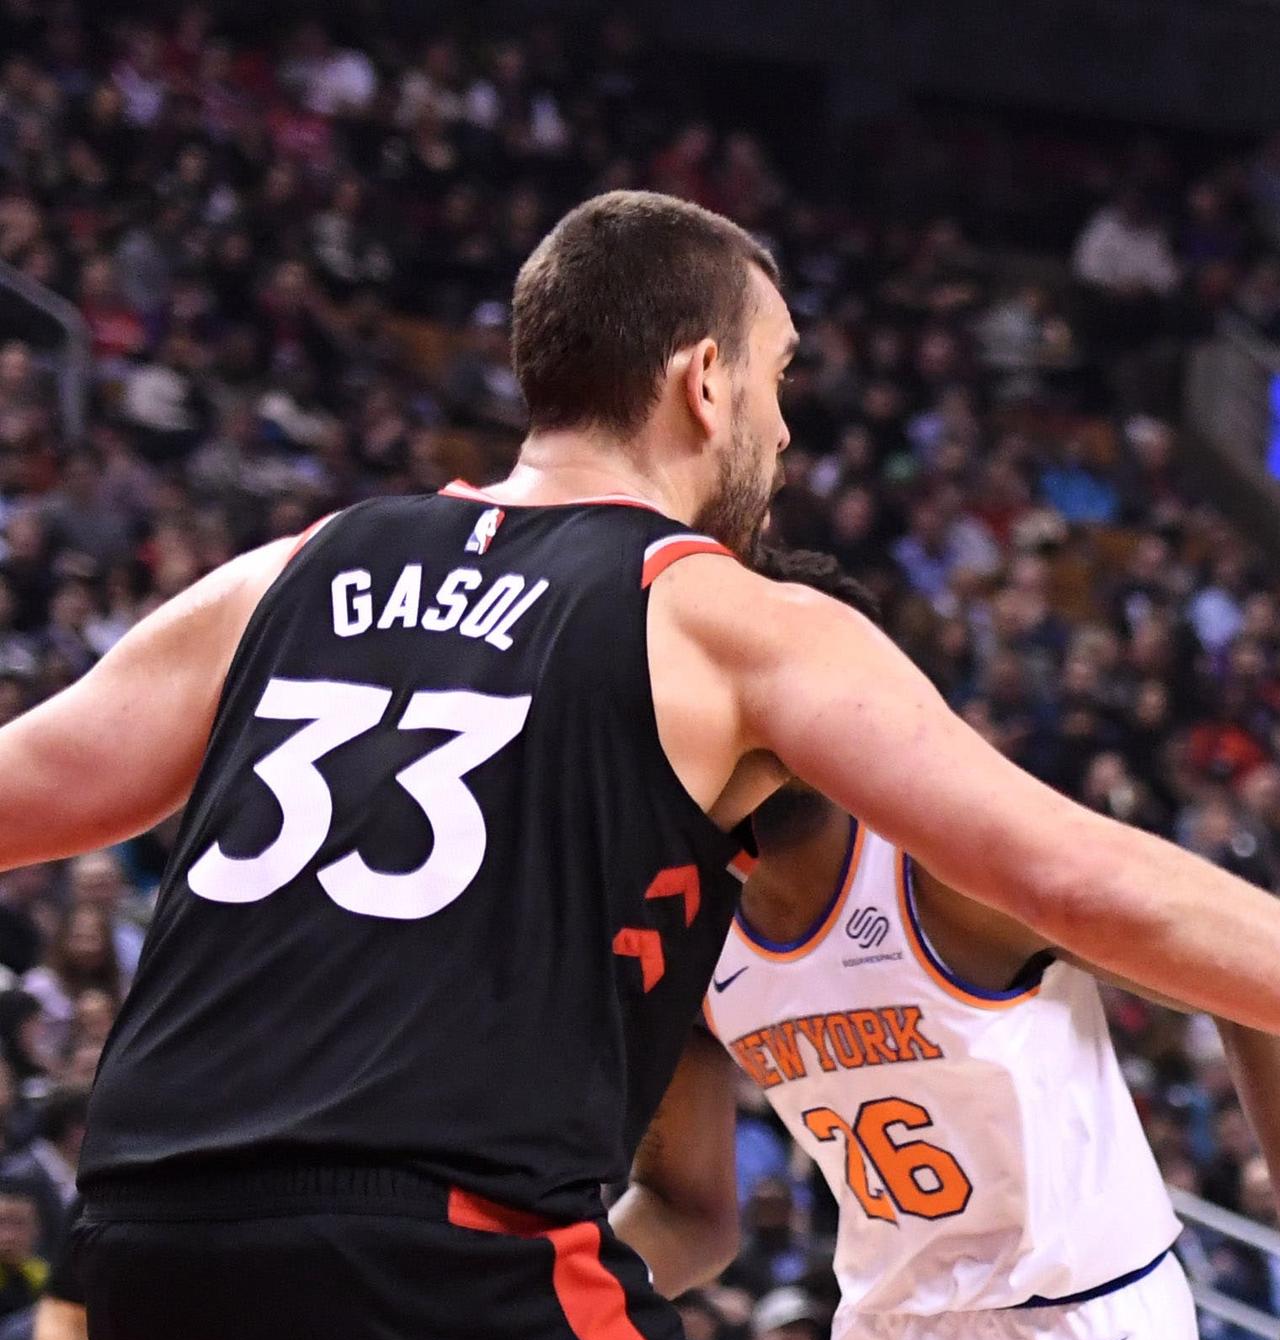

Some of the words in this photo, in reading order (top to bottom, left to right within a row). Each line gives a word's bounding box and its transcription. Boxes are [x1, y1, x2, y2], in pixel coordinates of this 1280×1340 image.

[331, 562, 549, 651] GASOL
[187, 678, 532, 920] 33
[796, 1004, 944, 1073] YORK
[801, 1096, 973, 1228] 26
